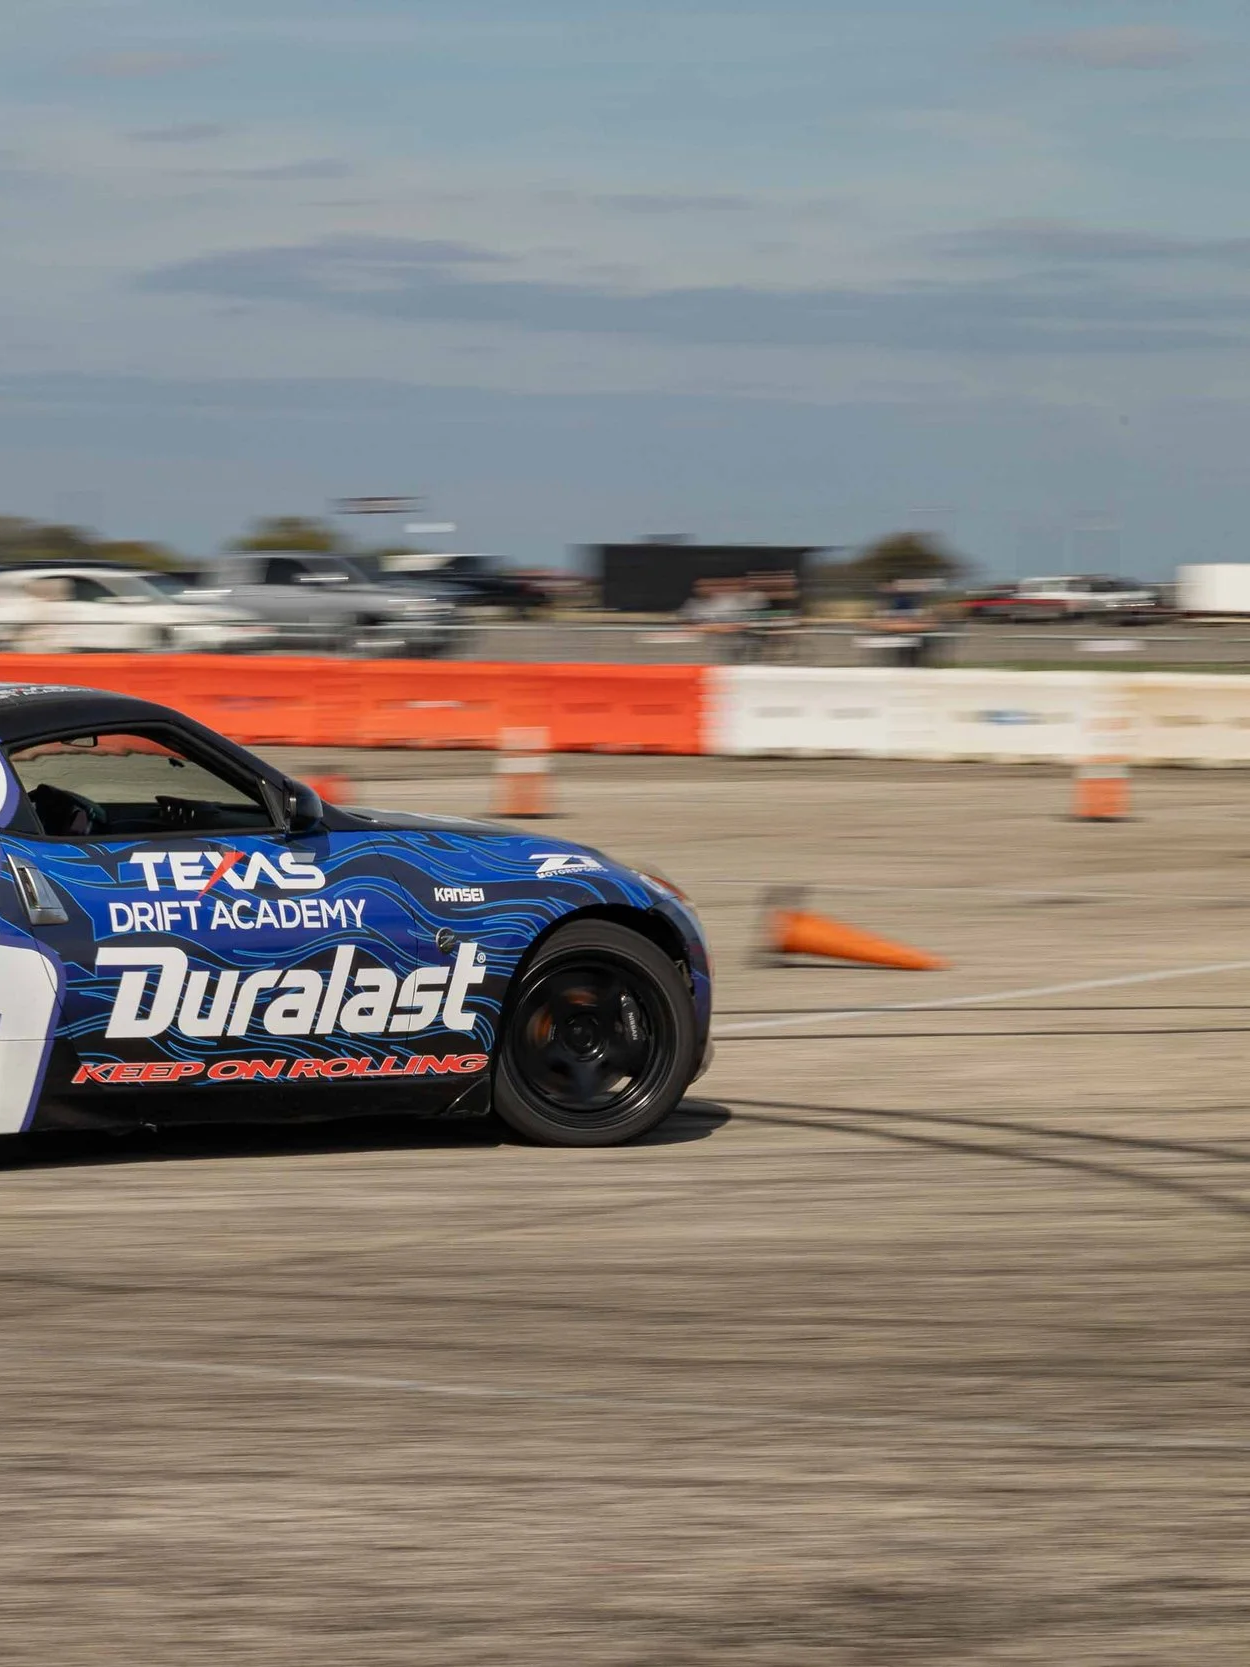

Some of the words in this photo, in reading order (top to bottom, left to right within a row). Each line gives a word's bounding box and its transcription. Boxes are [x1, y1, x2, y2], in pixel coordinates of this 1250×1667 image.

[129, 850, 326, 899] TEXAS
[433, 887, 485, 902] KANSEI
[110, 900, 203, 932] DRIFT
[212, 899, 366, 930] ACADEMY
[71, 1062, 205, 1084] KEEP
[207, 1060, 286, 1081] ON
[288, 1053, 490, 1079] ROLLING
